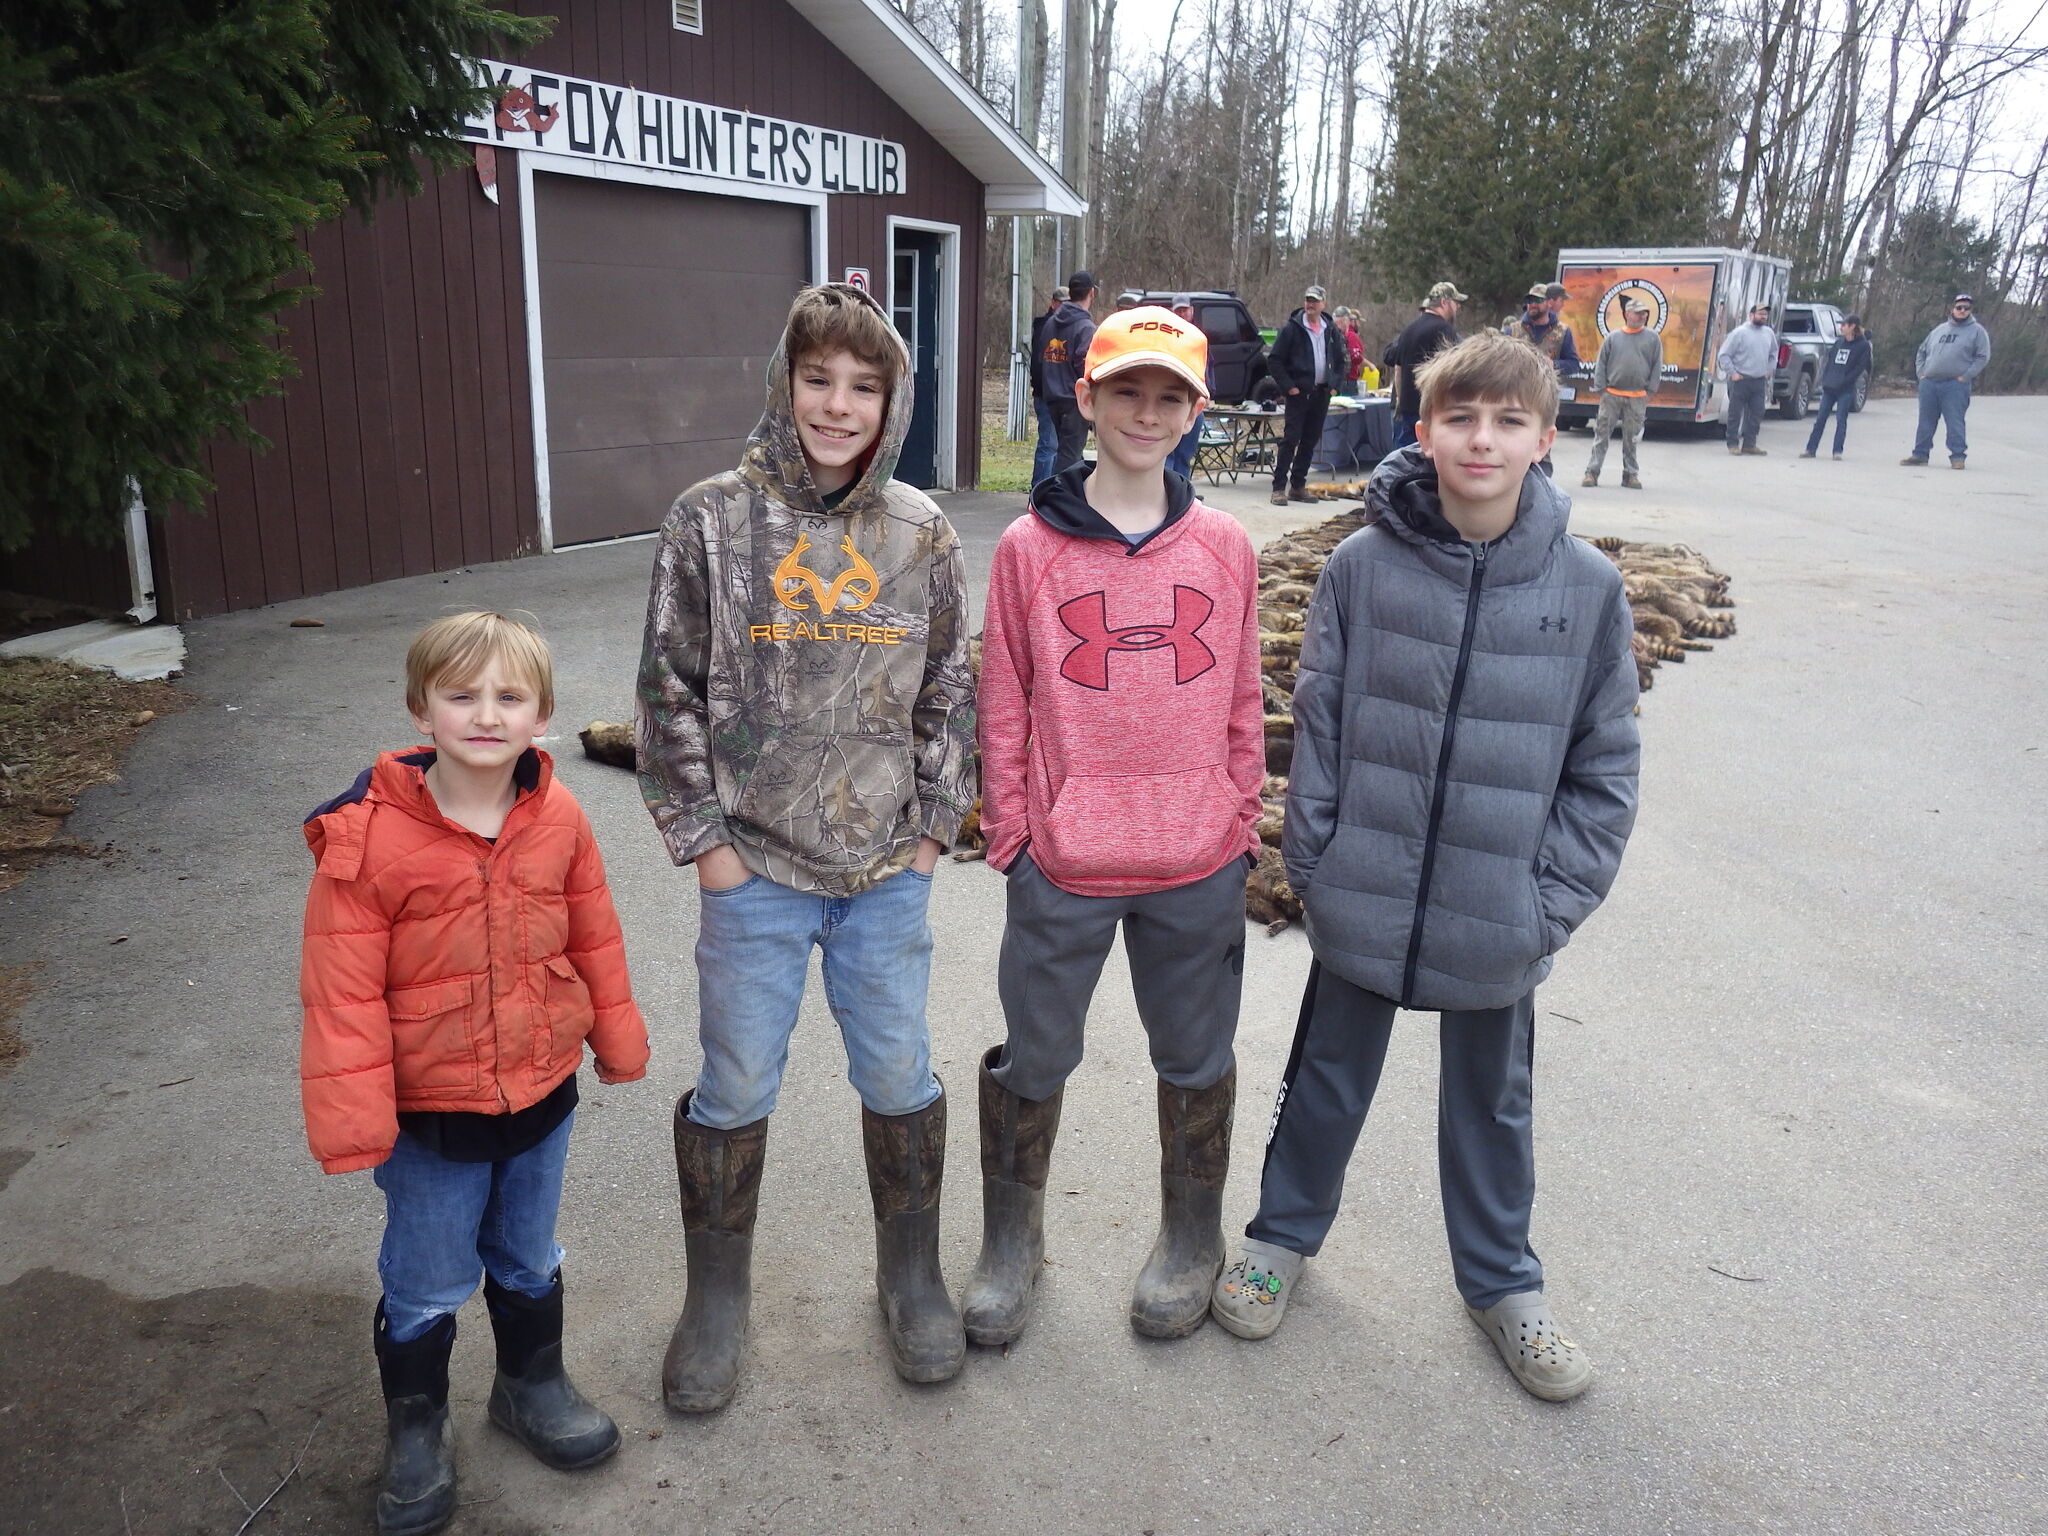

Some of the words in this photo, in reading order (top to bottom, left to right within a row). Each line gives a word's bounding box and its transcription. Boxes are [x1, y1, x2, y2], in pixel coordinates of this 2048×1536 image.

[531, 74, 625, 159] FOX
[820, 132, 899, 194] CLUB
[1129, 321, 1184, 338] POET
[1938, 334, 1959, 344] CAT
[1267, 1080, 1289, 1146] UNDER
